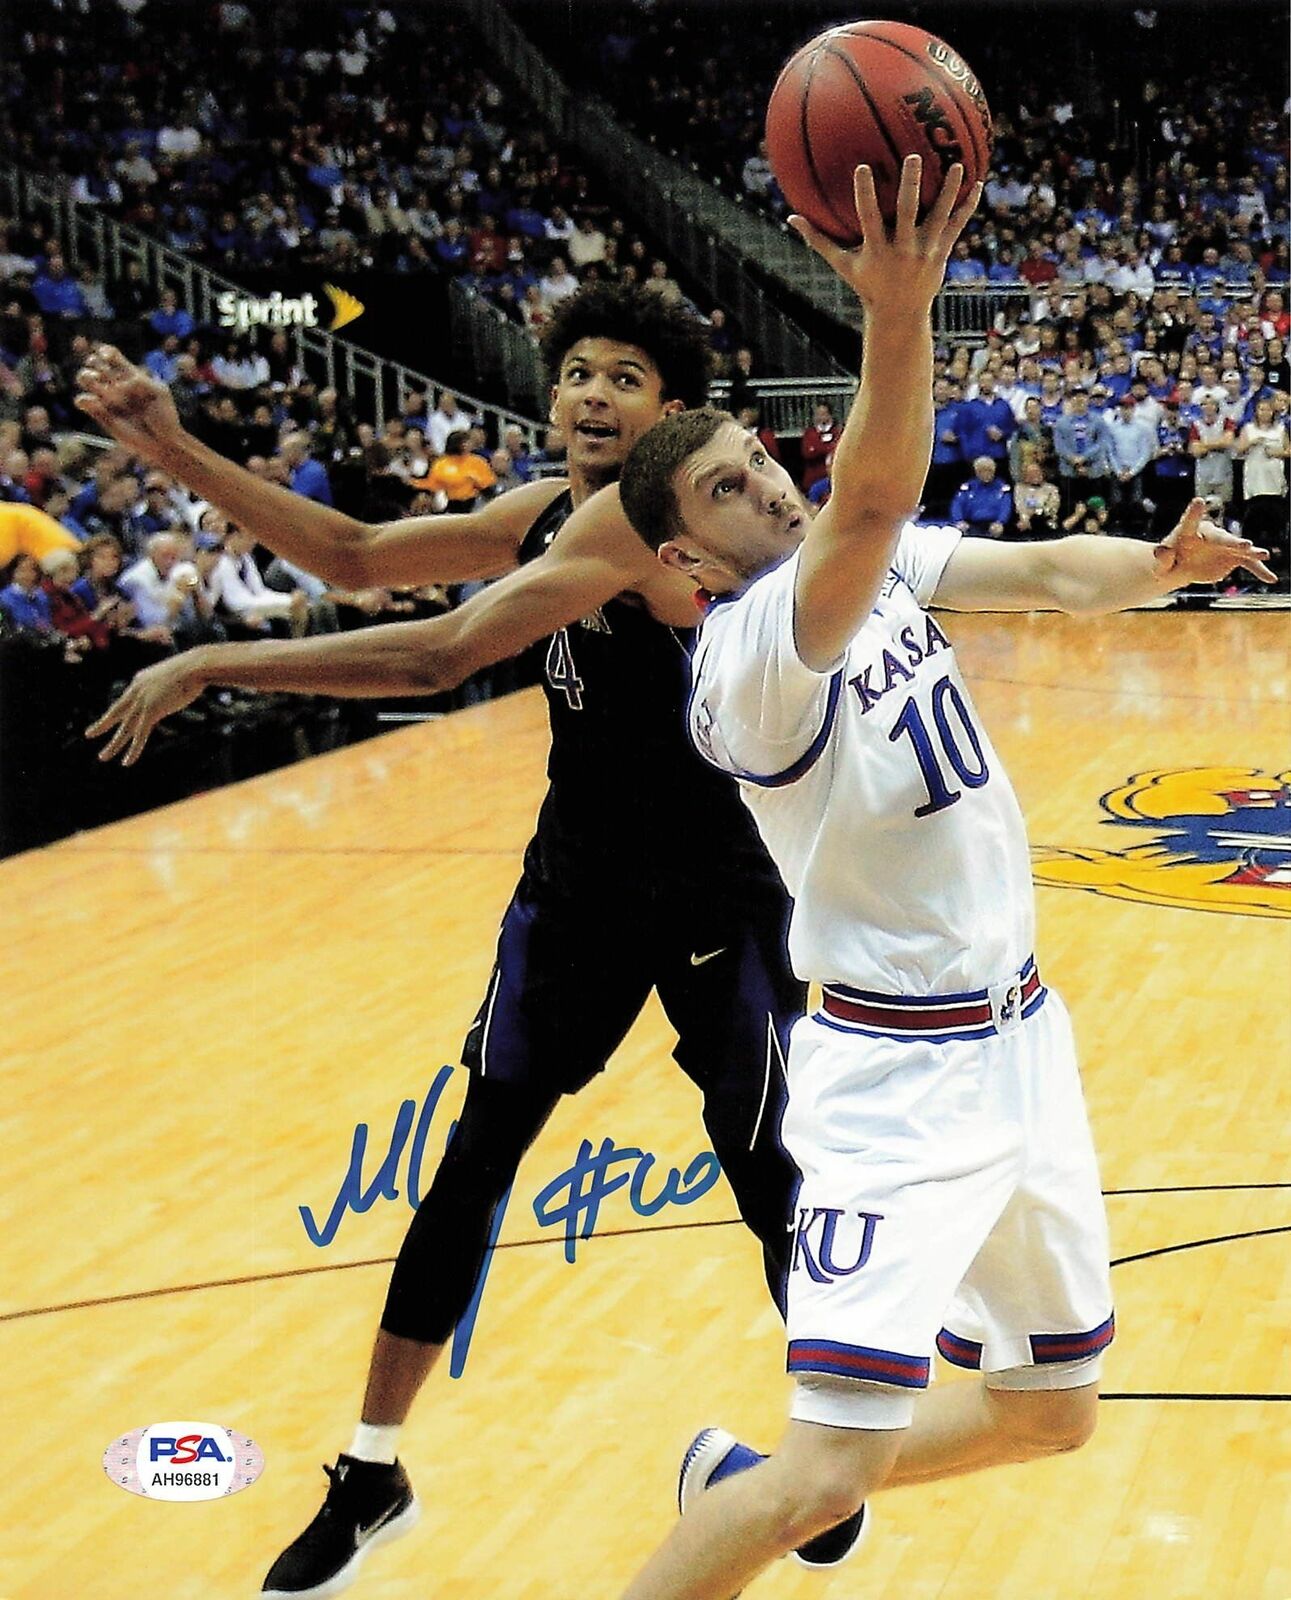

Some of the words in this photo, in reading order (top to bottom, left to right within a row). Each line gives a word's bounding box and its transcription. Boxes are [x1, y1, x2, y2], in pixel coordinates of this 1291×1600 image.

[217, 291, 318, 335] Sprint
[545, 627, 584, 710] 4
[888, 674, 990, 818] 10
[792, 1207, 885, 1284] KU
[151, 1472, 219, 1487] AH96881
